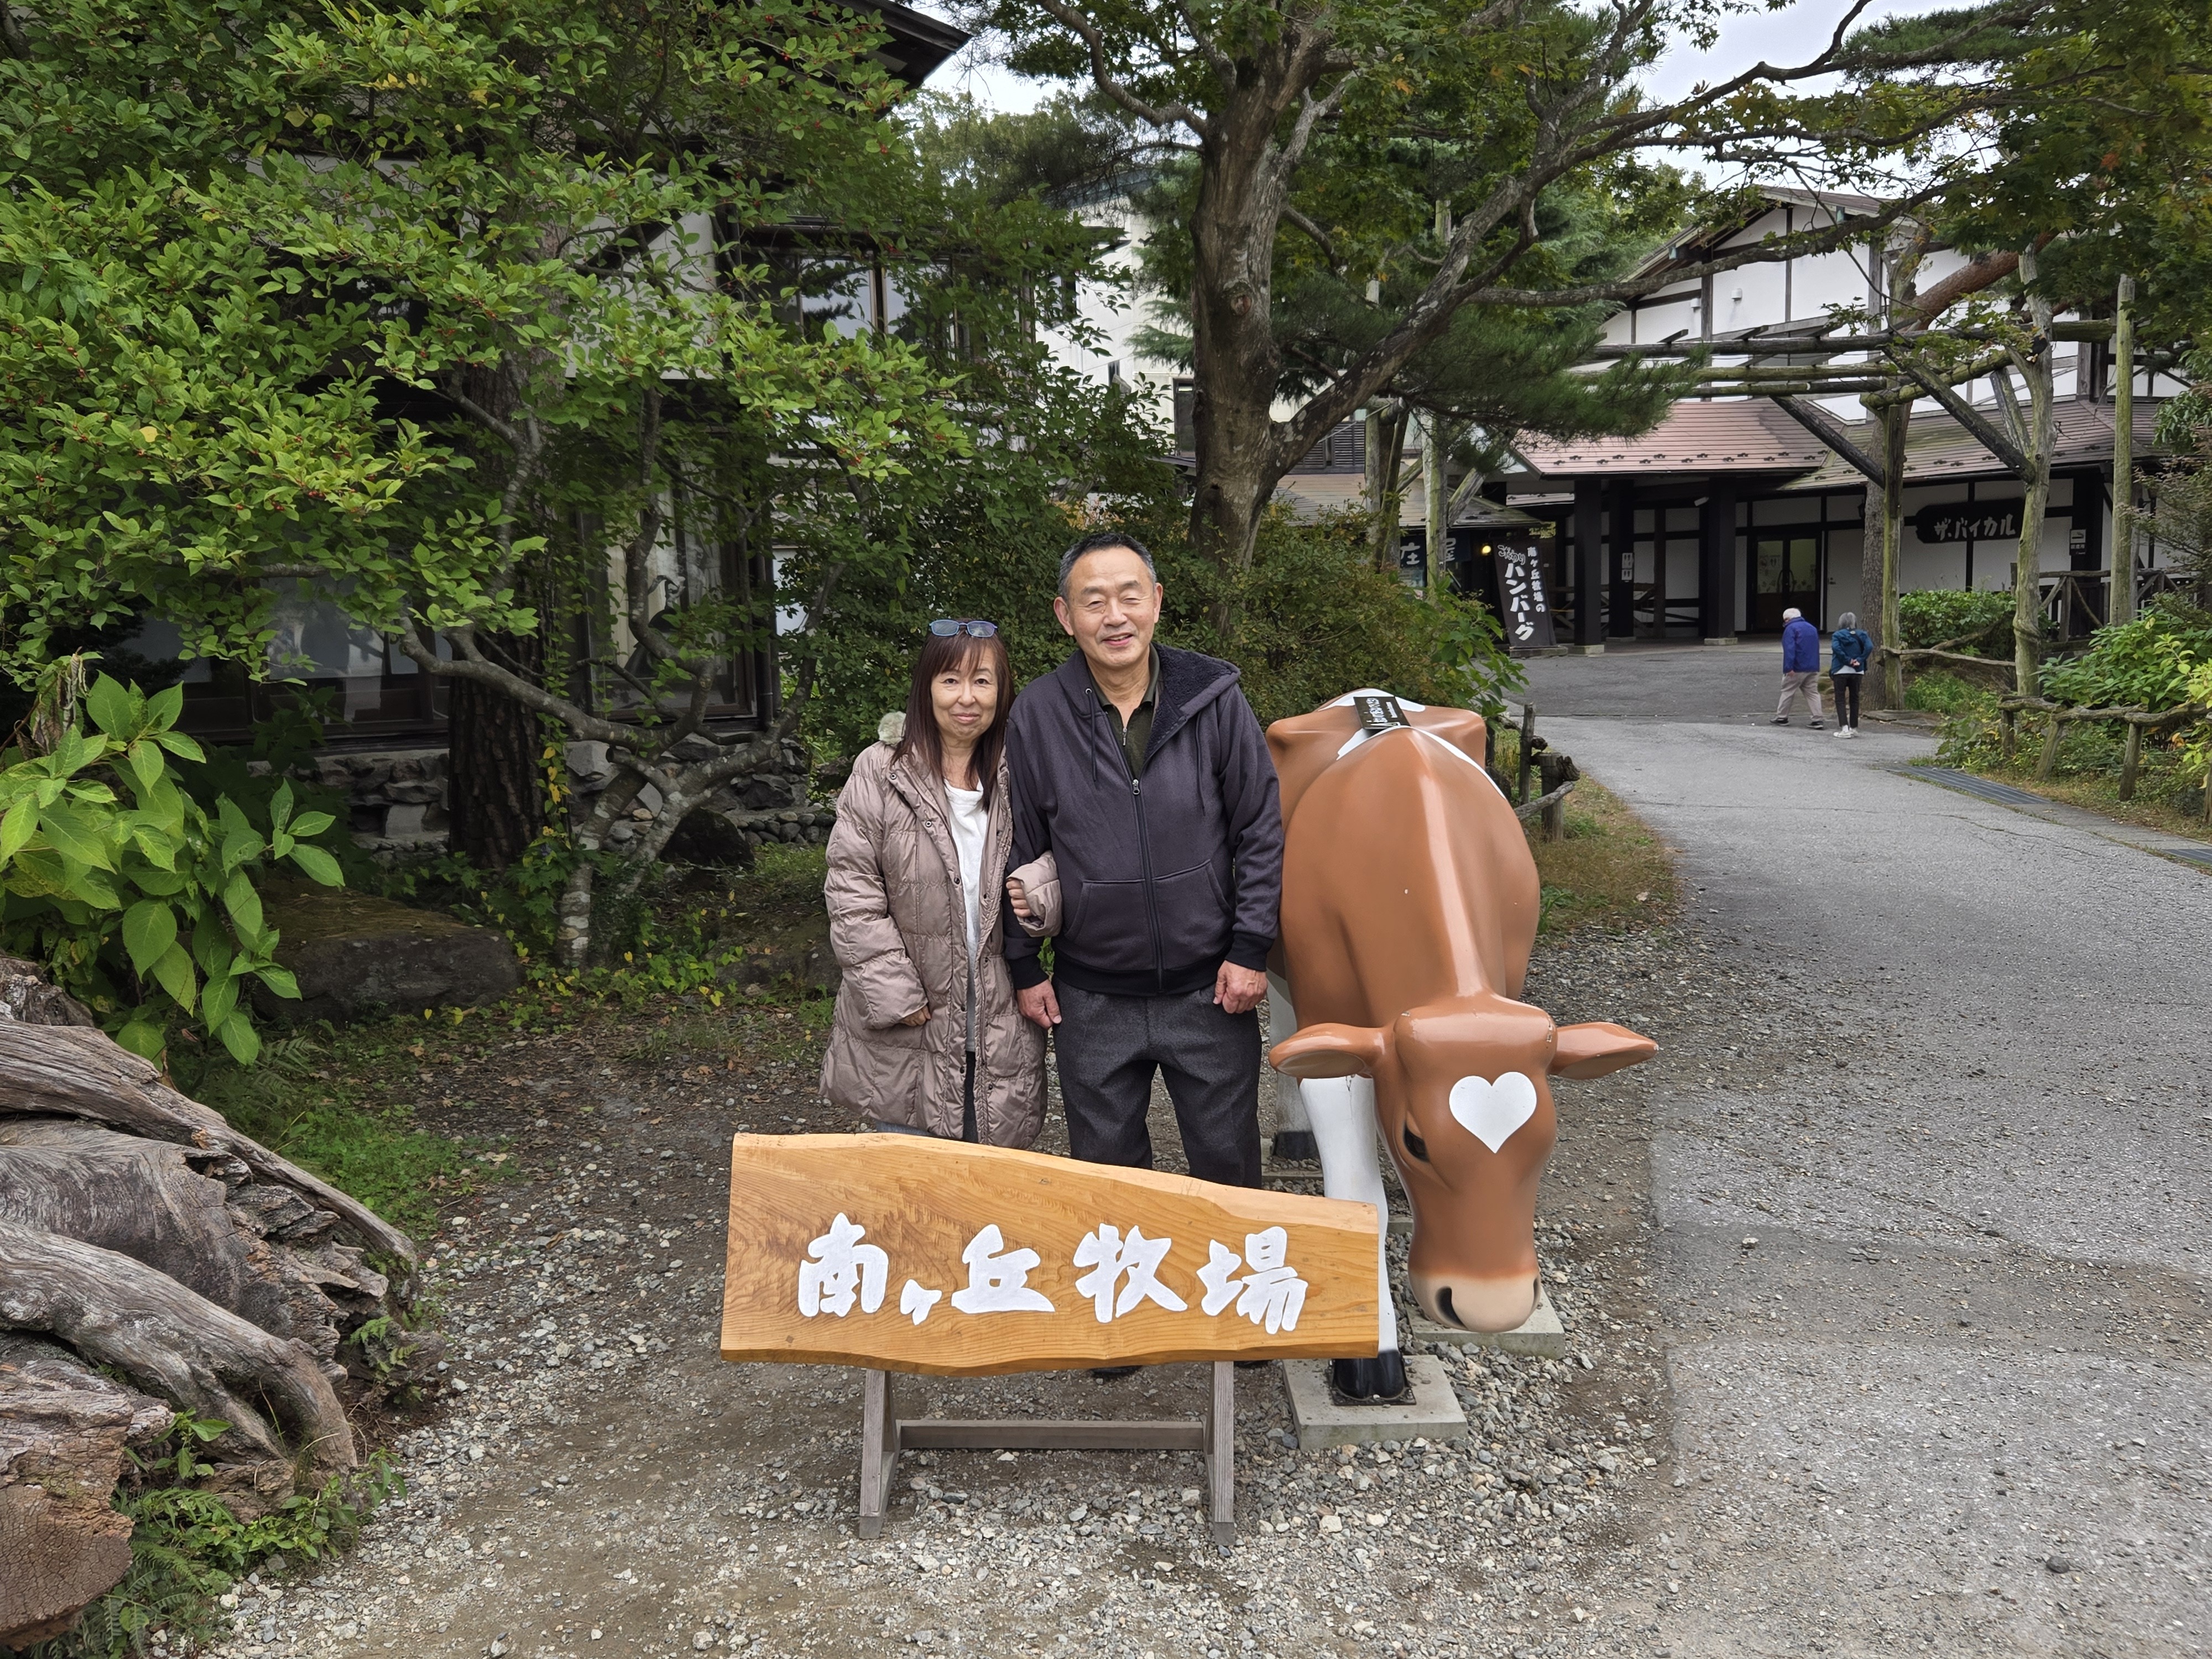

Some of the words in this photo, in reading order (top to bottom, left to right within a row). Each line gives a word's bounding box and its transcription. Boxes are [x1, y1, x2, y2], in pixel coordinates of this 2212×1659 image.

[1505, 563, 1534, 640] ハンバーグ
